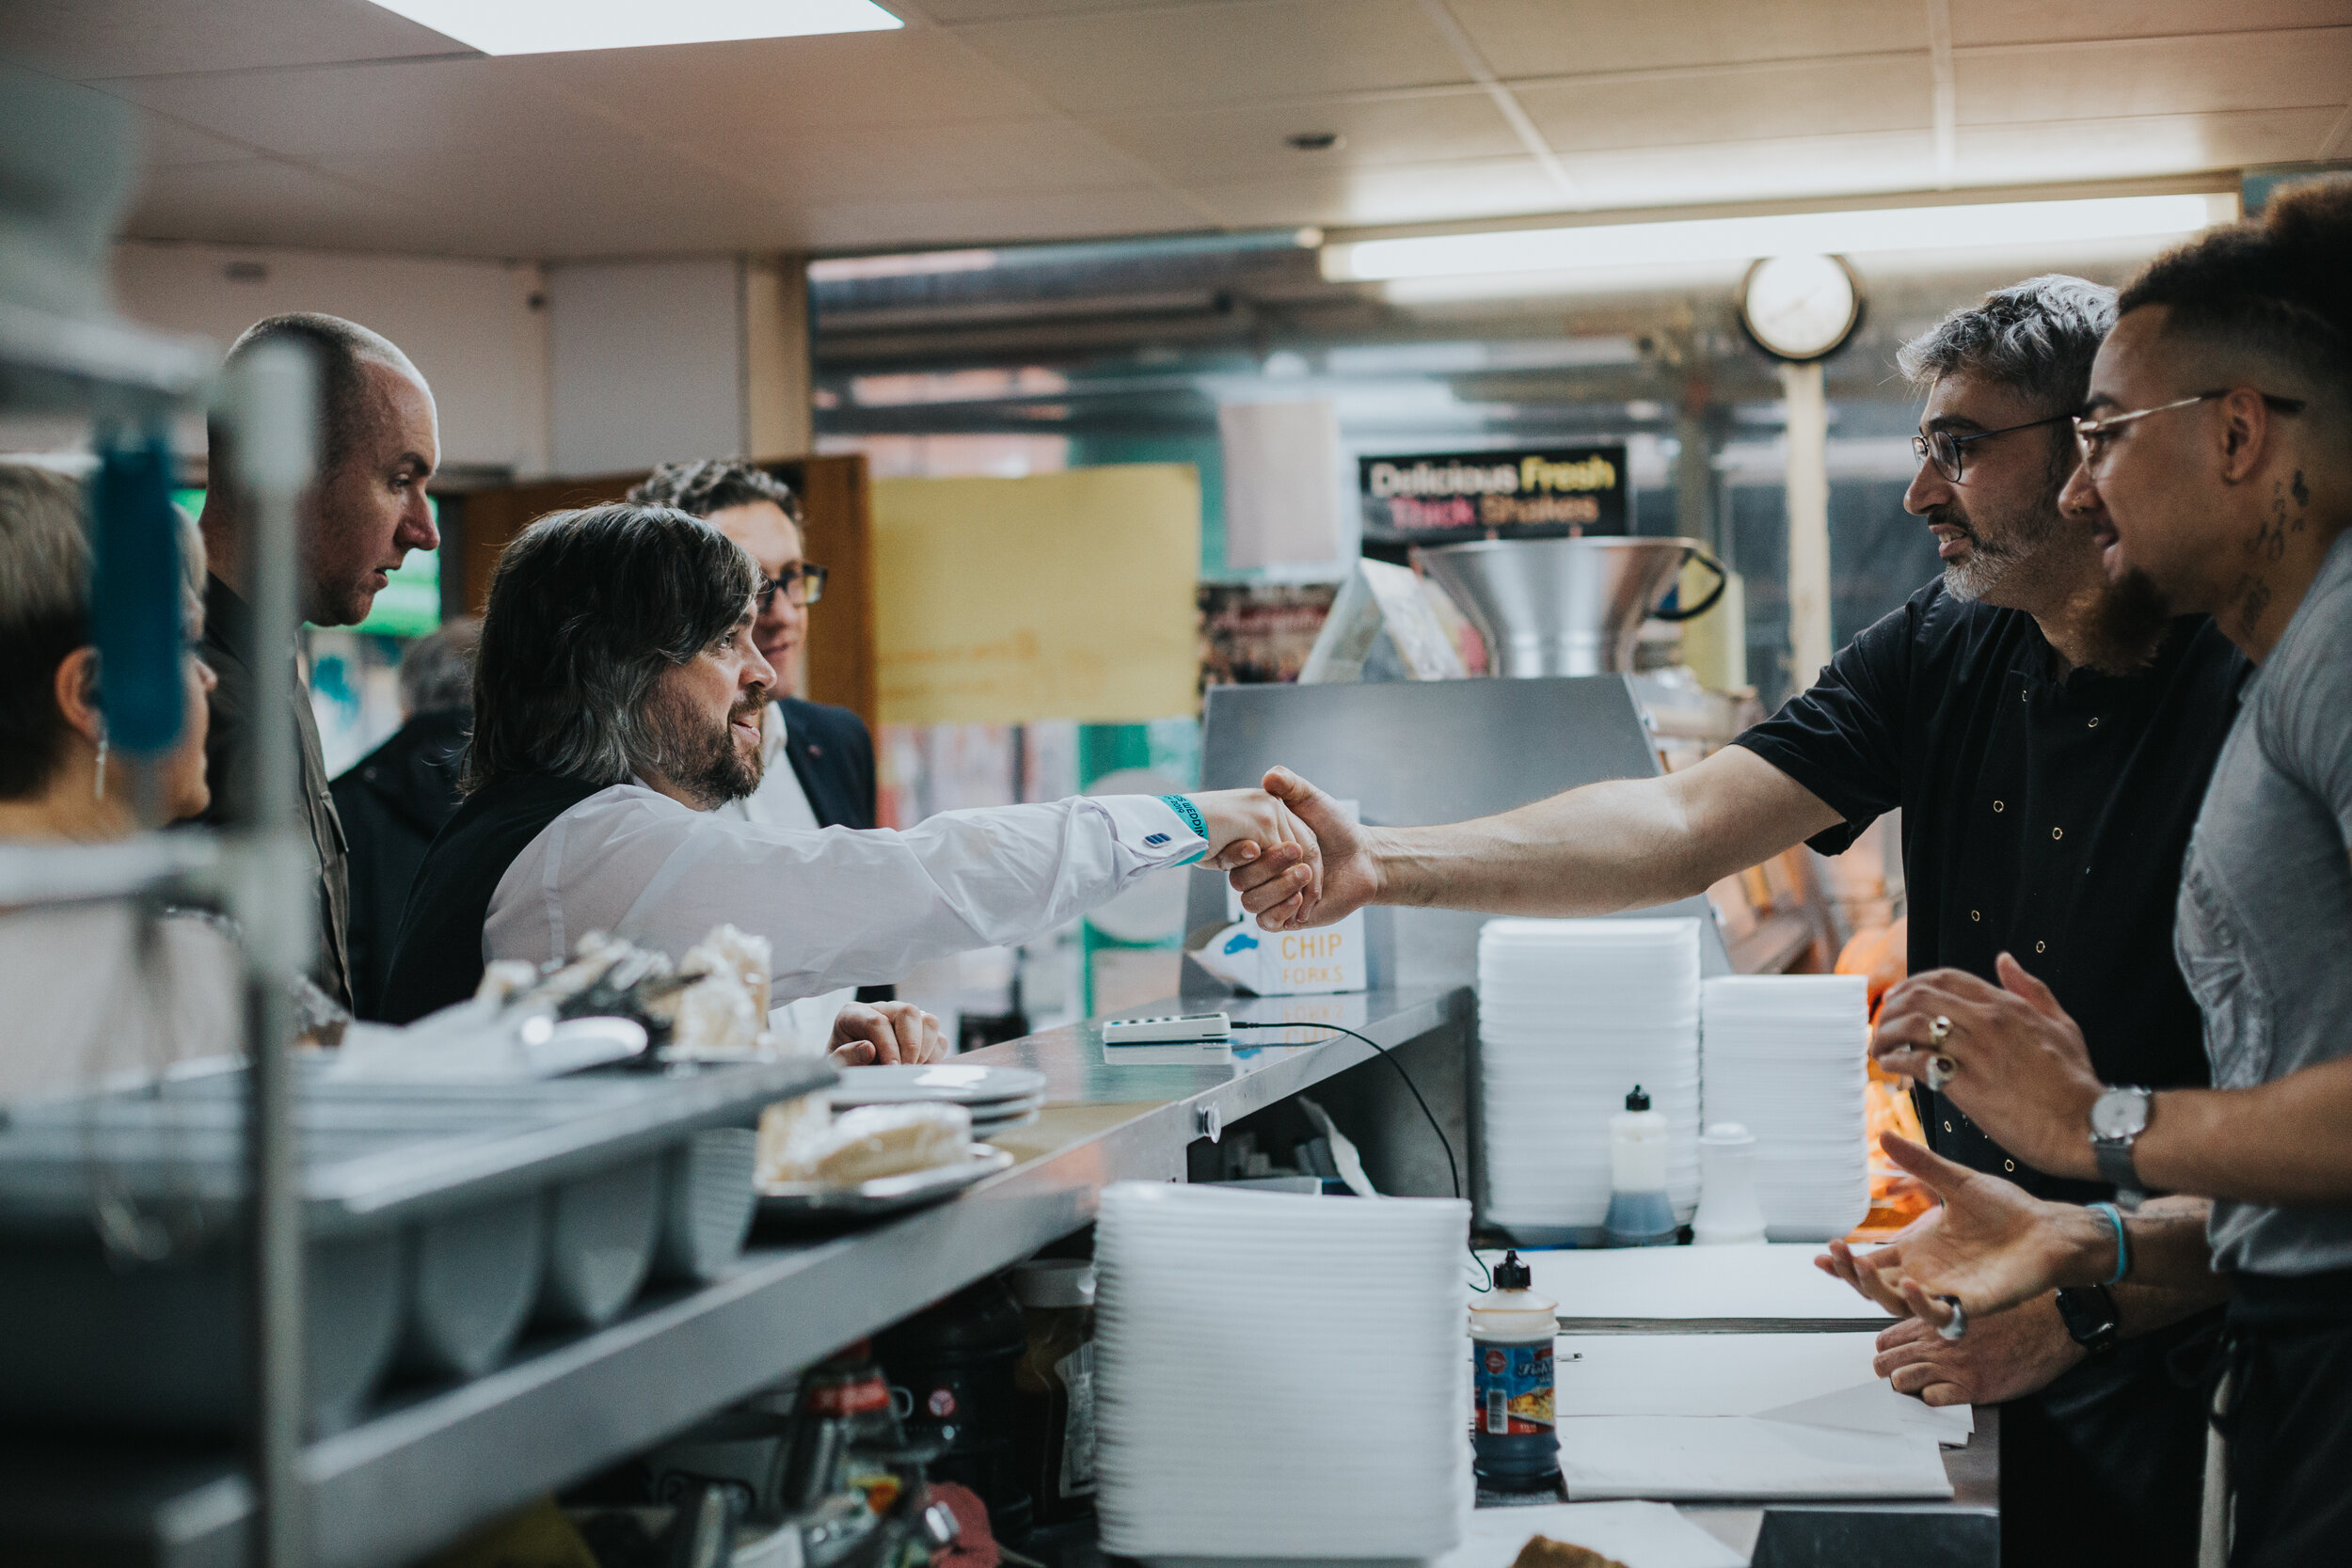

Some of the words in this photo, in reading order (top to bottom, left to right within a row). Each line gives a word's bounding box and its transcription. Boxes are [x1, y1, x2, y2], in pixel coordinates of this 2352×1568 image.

[1371, 461, 1518, 495] Delicious
[1520, 455, 1615, 492] Fresh
[1182, 800, 1205, 837] WEDDIN
[1282, 934, 1343, 960] CHIP
[1282, 965, 1343, 986] FORKS
